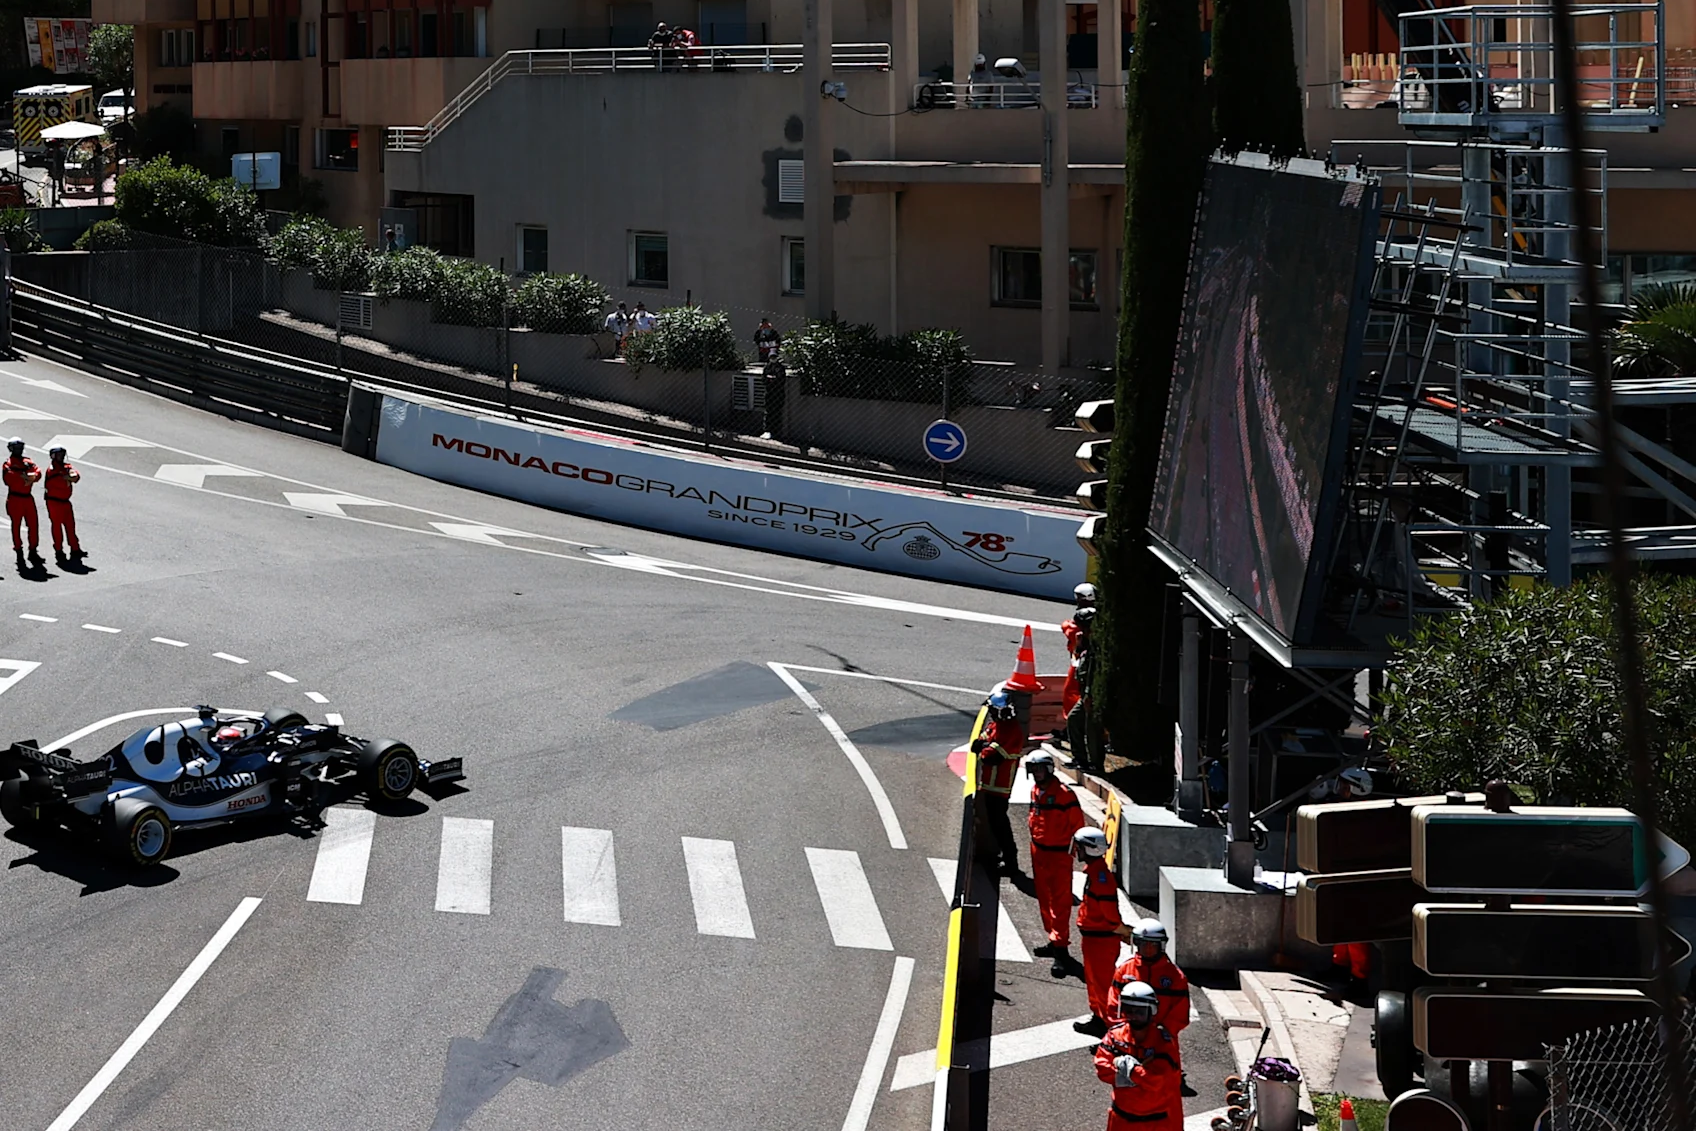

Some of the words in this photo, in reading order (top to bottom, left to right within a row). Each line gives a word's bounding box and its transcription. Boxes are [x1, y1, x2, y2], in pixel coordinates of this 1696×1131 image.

[707, 508, 786, 530] SINCE
[793, 522, 856, 541] 1929
[20, 747, 77, 772] HONDA
[227, 794, 267, 809] HONDA
